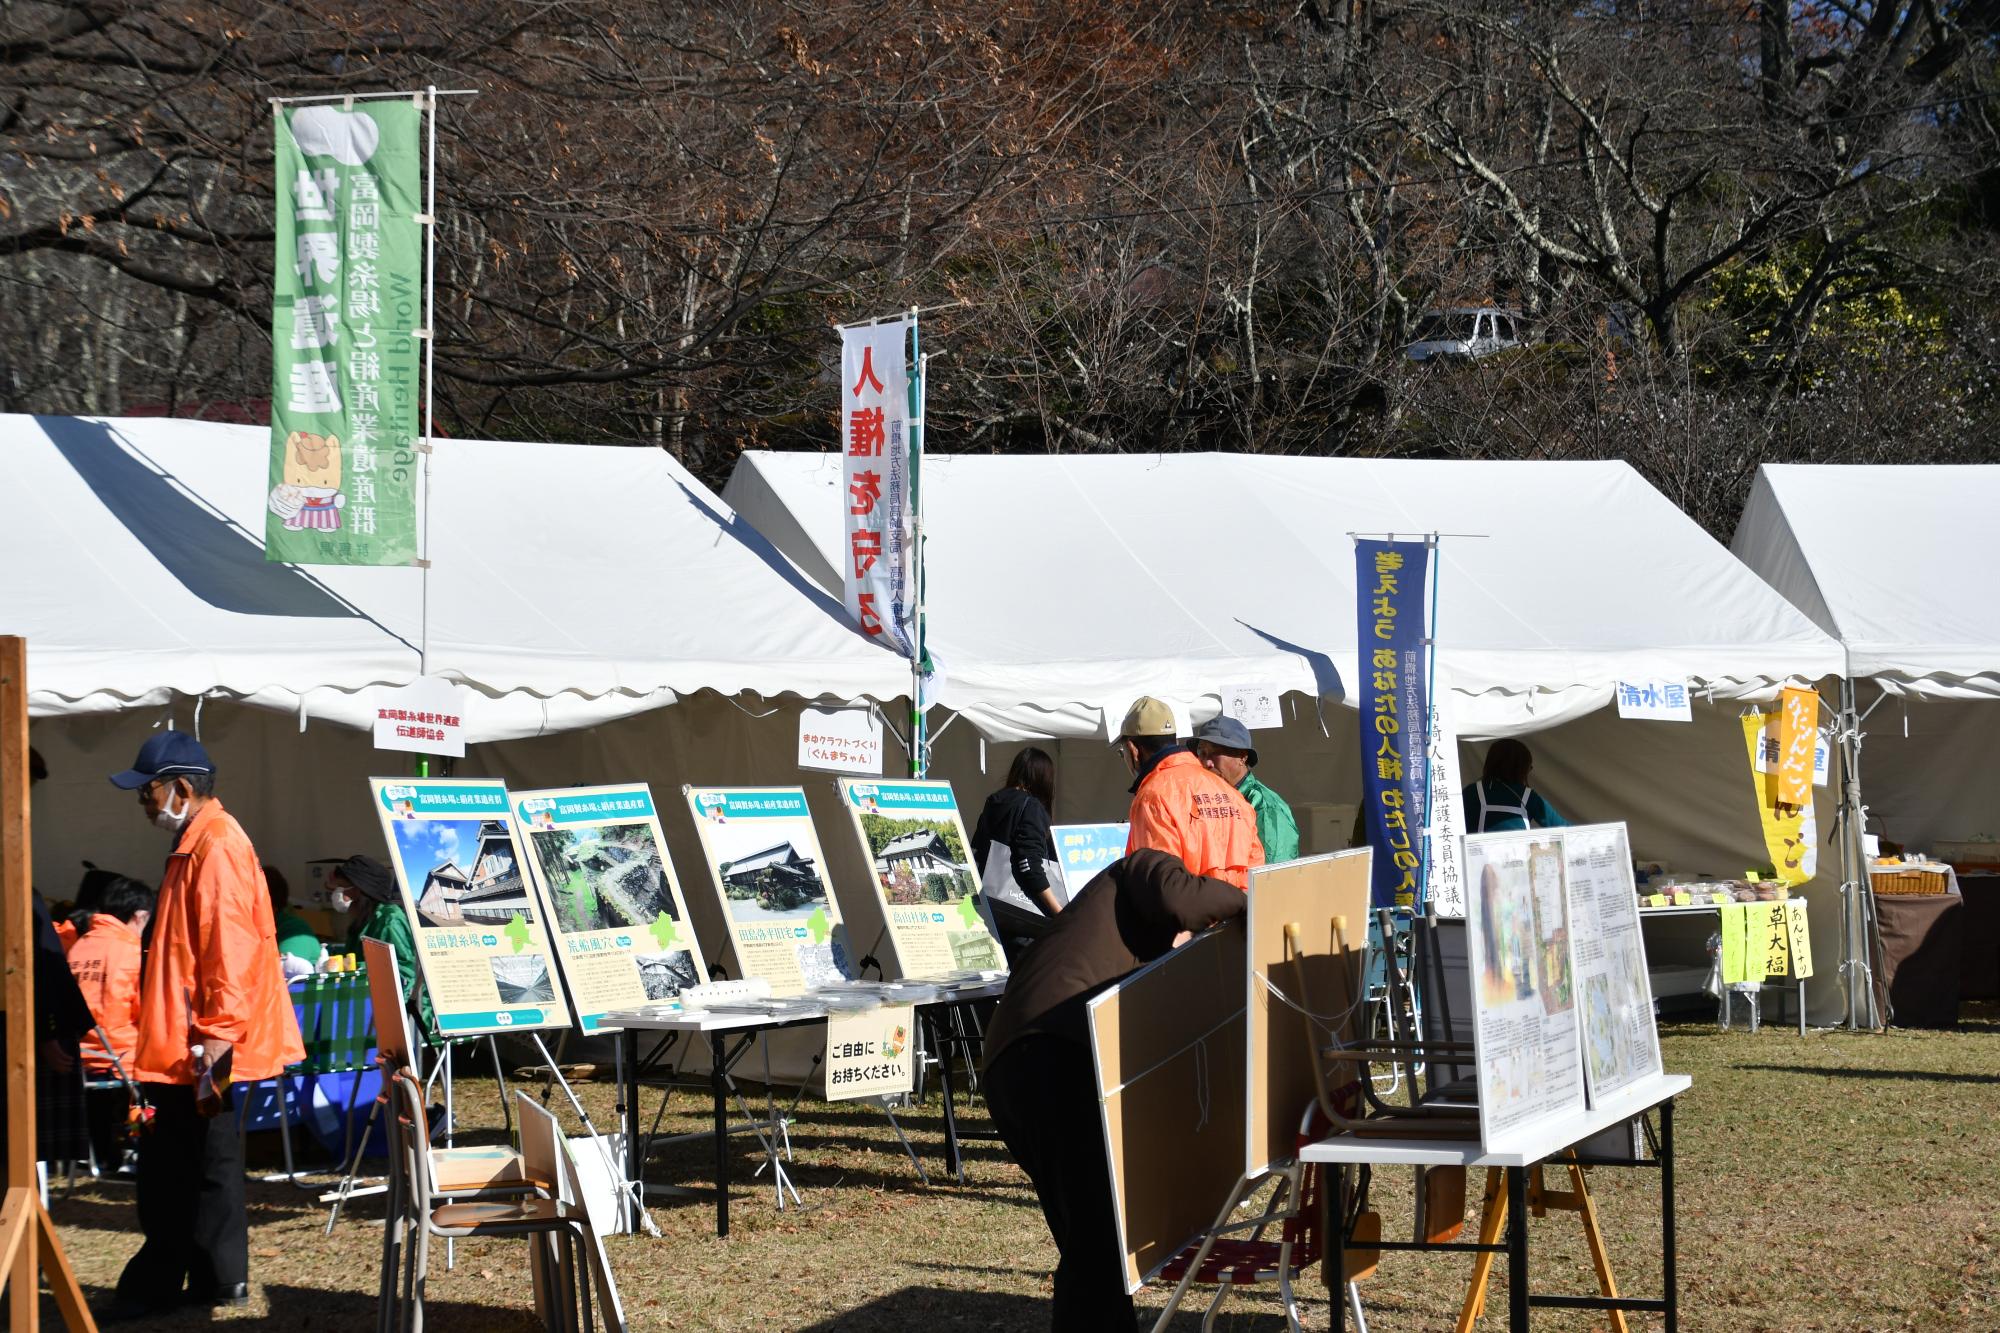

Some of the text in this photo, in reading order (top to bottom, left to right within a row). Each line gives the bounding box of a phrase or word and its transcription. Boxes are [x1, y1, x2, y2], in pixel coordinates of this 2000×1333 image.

[1619, 681, 1687, 709] 清水屋
[377, 708, 461, 727] 富岡製糸場世界遺産
[396, 725, 445, 741] 伝道師協会
[802, 733, 877, 750] まゆクラフトづくり
[1067, 846, 1126, 864] まゆクラ
[424, 932, 481, 949] 富岡製糸場
[1766, 905, 1787, 974] 草大福
[1791, 905, 1807, 976] あんドーナツ
[832, 1041, 875, 1059] ご自由に
[831, 1063, 906, 1085] お持ちください。
